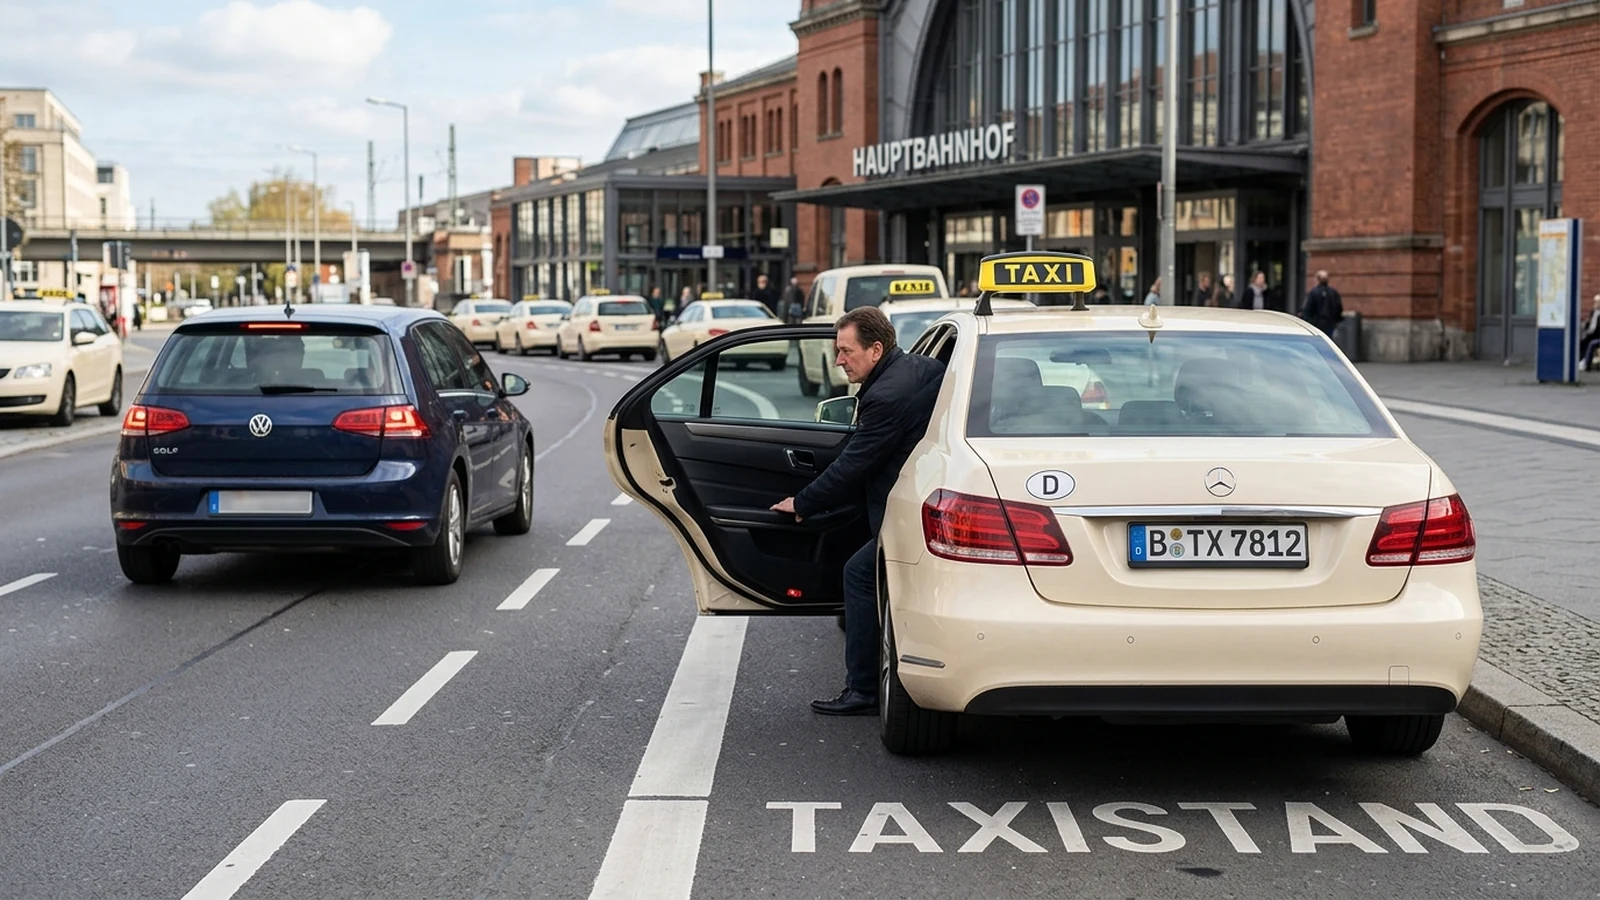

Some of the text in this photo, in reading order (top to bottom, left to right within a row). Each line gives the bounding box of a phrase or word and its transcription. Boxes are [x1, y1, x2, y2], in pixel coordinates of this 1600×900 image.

[853, 122, 1015, 177] HAUPTBAHNHOF
[1005, 264, 1072, 283] TAXI
[1043, 475, 1059, 495] D
[1150, 530, 1302, 556] B TX 7812
[766, 801, 1580, 854] TAXISTAND
